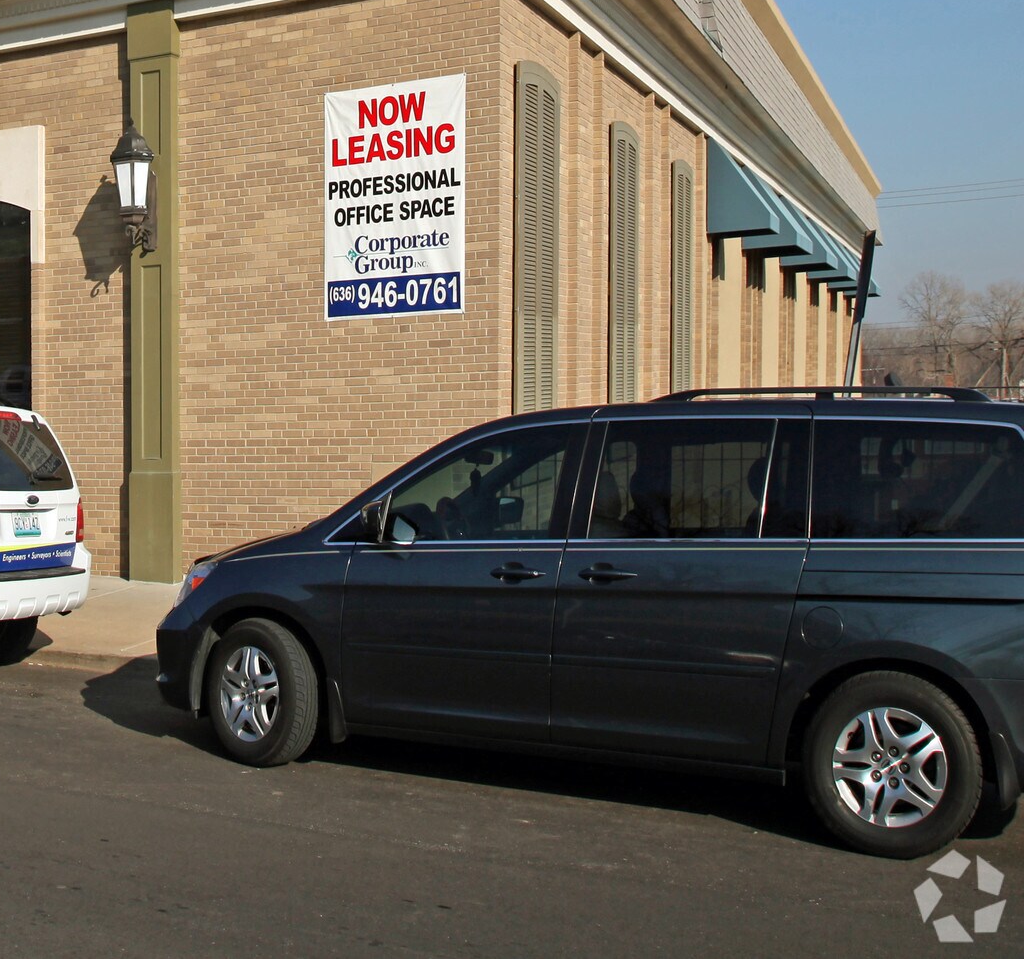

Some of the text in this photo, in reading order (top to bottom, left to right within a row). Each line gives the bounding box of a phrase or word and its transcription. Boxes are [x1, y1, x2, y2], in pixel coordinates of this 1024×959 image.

[358, 91, 426, 129] NOW
[332, 123, 455, 167] LEASING
[328, 167, 461, 200] PROFESSIONAL
[334, 196, 455, 227] OFFICE SPACE
[354, 229, 450, 255] Corporate
[354, 254, 414, 274] Group
[329, 276, 458, 309] (636) 946-0761
[2, 553, 26, 563] Engineers
[31, 552, 52, 560] Surveyors
